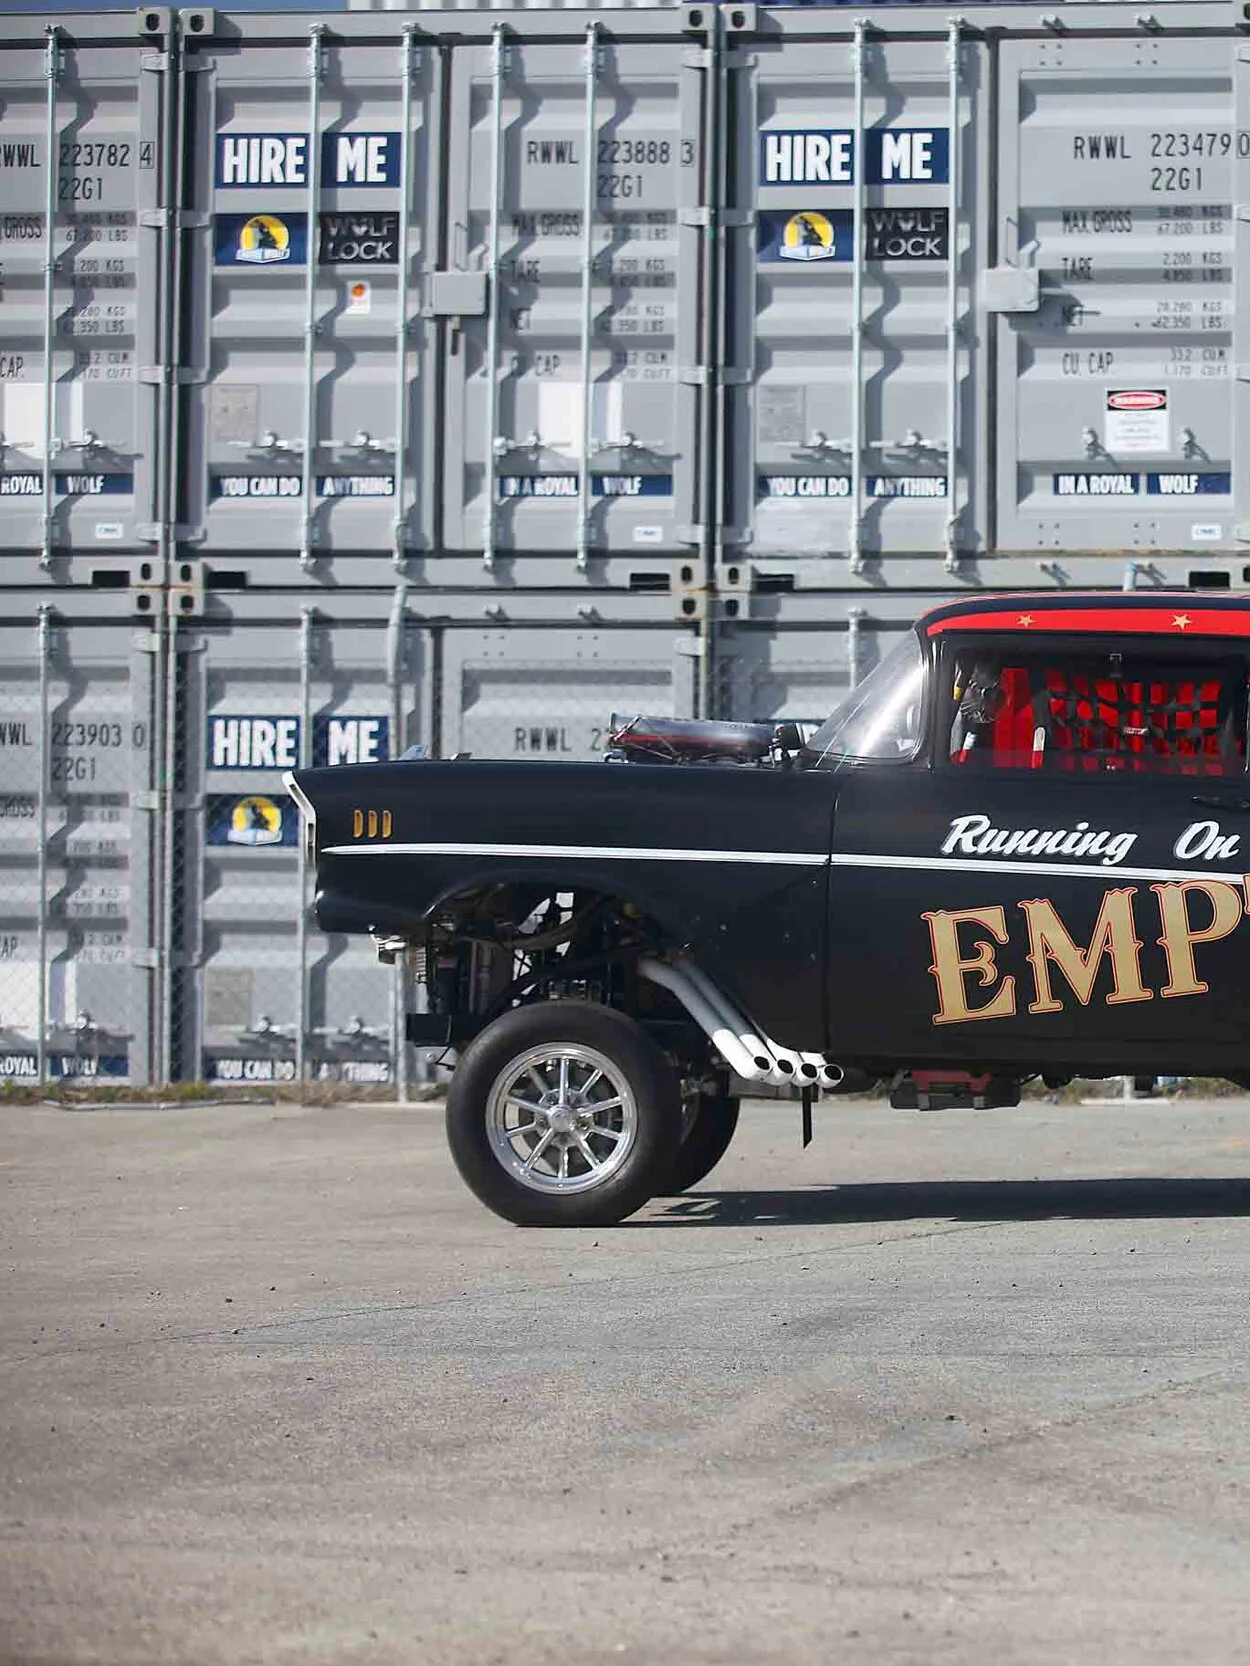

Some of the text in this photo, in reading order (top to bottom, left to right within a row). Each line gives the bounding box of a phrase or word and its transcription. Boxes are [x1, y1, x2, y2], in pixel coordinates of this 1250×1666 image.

[0, 142, 153, 168] WWL 223782 4
[527, 140, 695, 166] RWWL 223888 3
[766, 132, 934, 182] HIRE ME
[1073, 135, 1132, 160] RWWL
[1150, 133, 1232, 157] 223479
[223, 136, 388, 184] HIRE ME
[598, 174, 642, 198] 22G1
[1150, 167, 1203, 191] 22G1
[327, 241, 395, 261] LOCK
[873, 237, 943, 257] LOCK
[1, 475, 105, 495] ROYAL WOLF
[220, 476, 394, 496] YOU CAN DO ANYTHING
[534, 476, 578, 496] ROYAL
[602, 476, 642, 496] WOLF
[768, 476, 945, 497] YOU CAN DO ANYTHING
[1058, 474, 1199, 494] IN A ROYAL WOLF
[51, 723, 122, 747] 223903
[213, 719, 379, 767] HIRE ME
[514, 727, 573, 752] RWWL
[941, 813, 1241, 866] Running On
